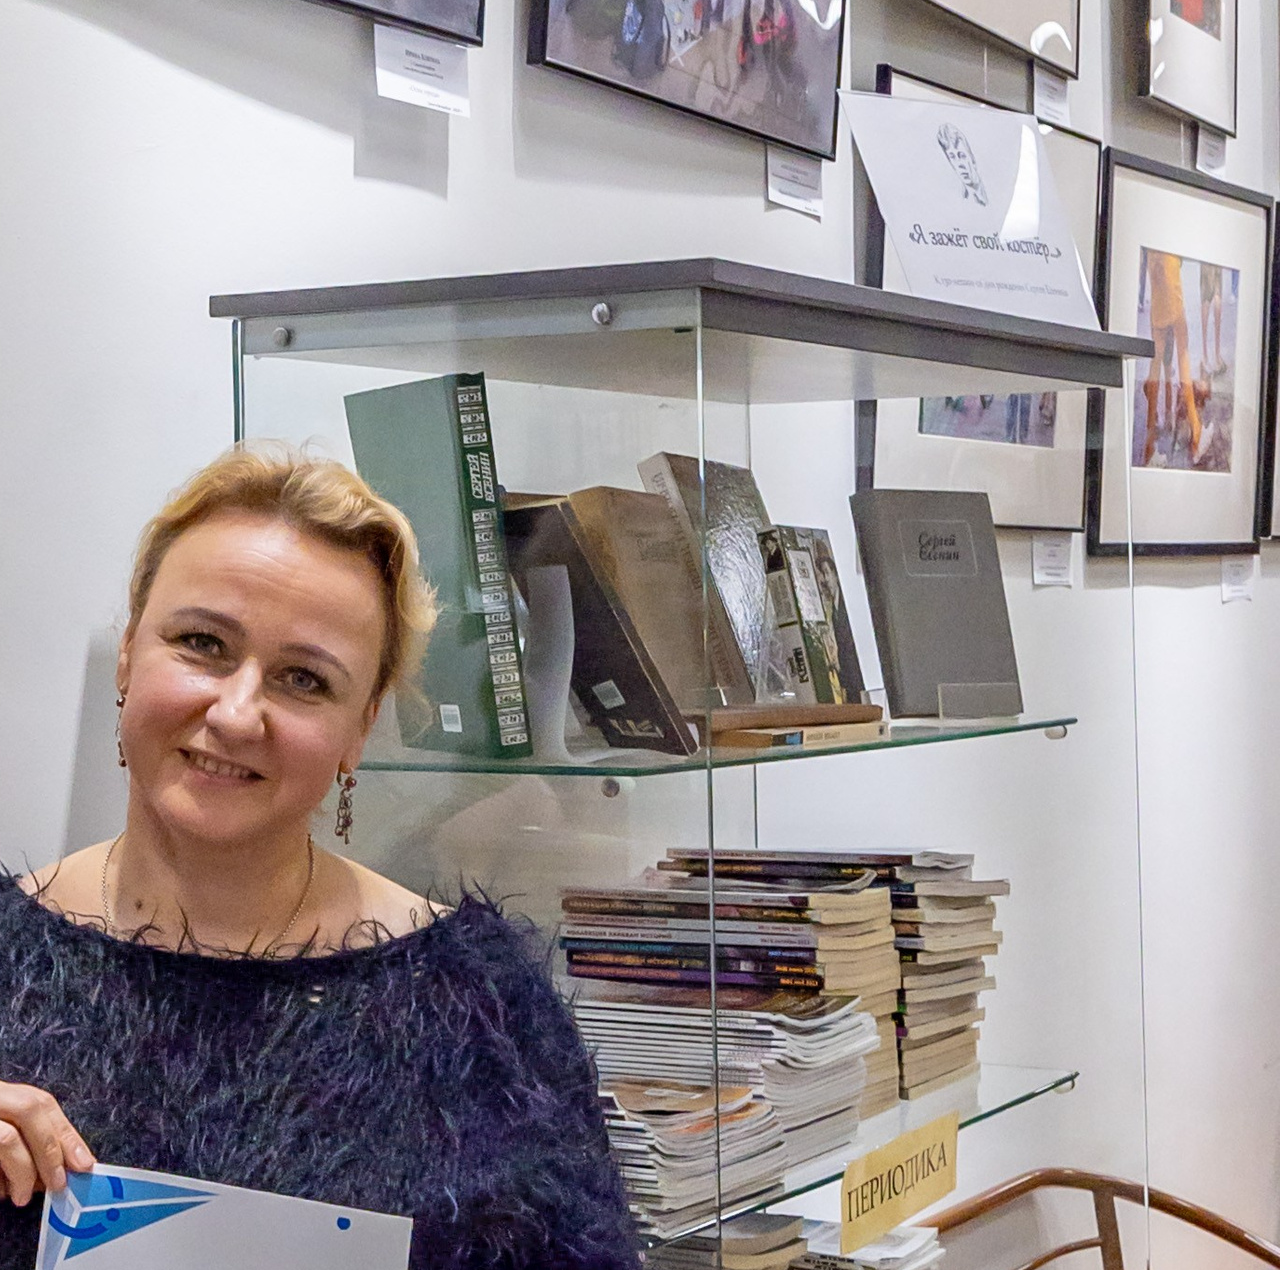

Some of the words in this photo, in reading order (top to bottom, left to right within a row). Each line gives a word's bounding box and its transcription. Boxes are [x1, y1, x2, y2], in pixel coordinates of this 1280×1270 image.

[909, 223, 927, 245] «Я
[972, 232, 1004, 251] свой
[466, 453, 483, 498] СЕРГЕЙ
[479, 452, 495, 502] ЕСЕНИН
[919, 531, 956, 550] Сергей
[919, 551, 960, 561] Есенин
[847, 1141, 947, 1223] ПЕРИОДИКА
